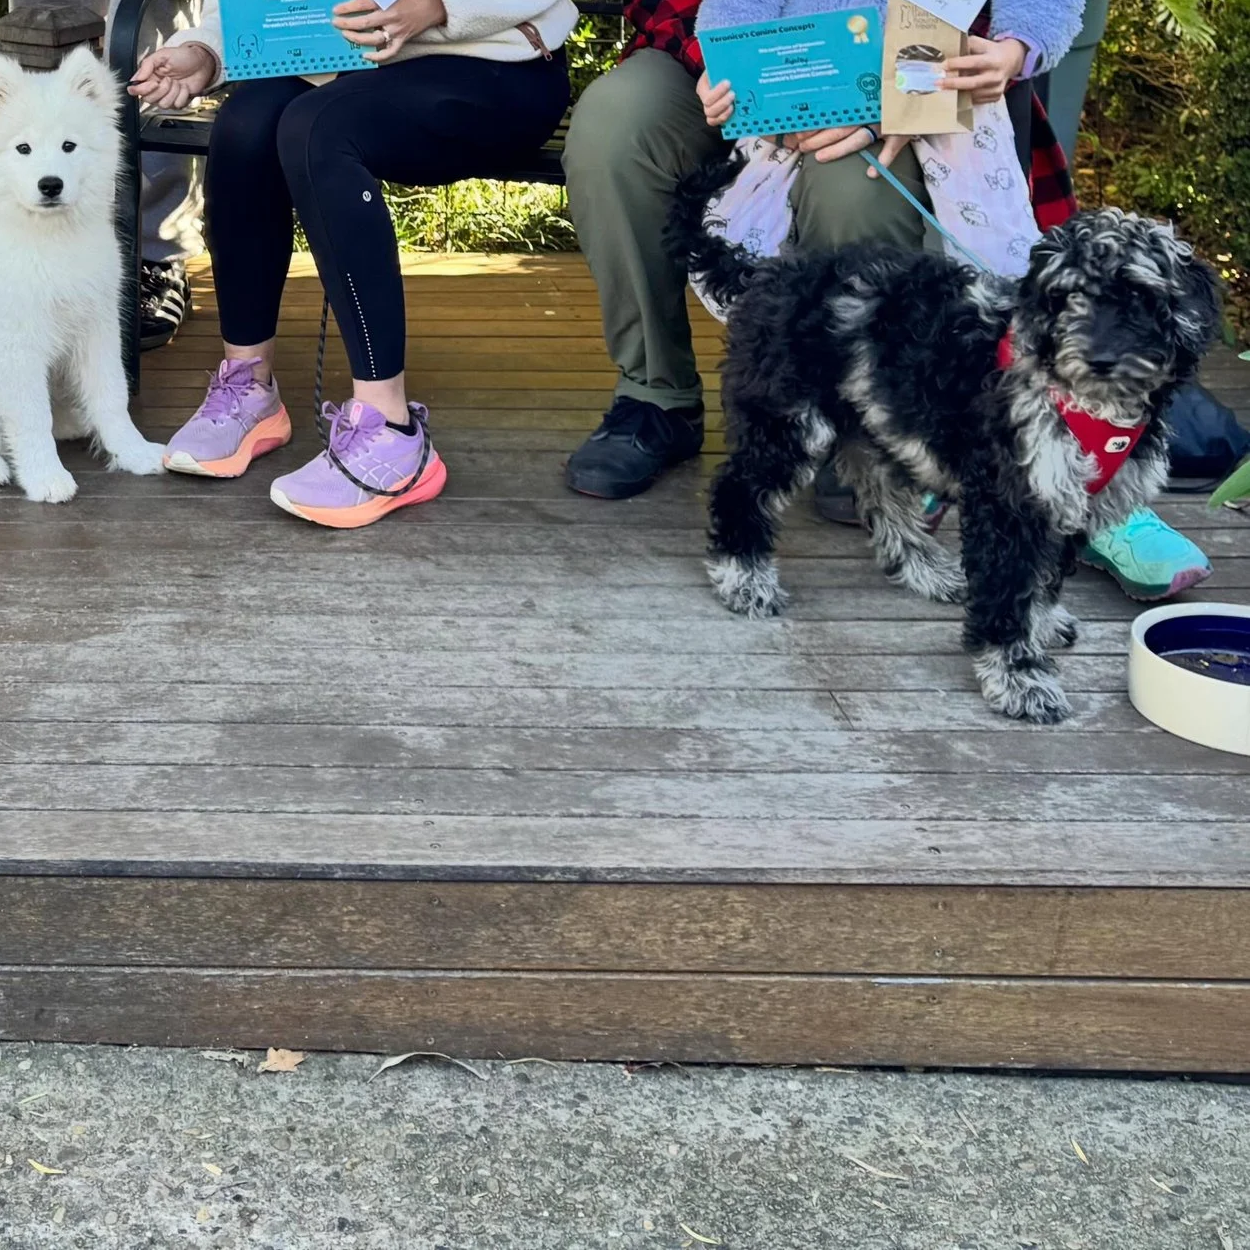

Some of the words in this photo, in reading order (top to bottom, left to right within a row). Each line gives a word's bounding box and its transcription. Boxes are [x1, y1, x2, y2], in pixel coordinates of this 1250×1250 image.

[709, 31, 749, 43] Veronica's
[749, 27, 777, 38] Canine
[778, 22, 815, 34] Concepts
